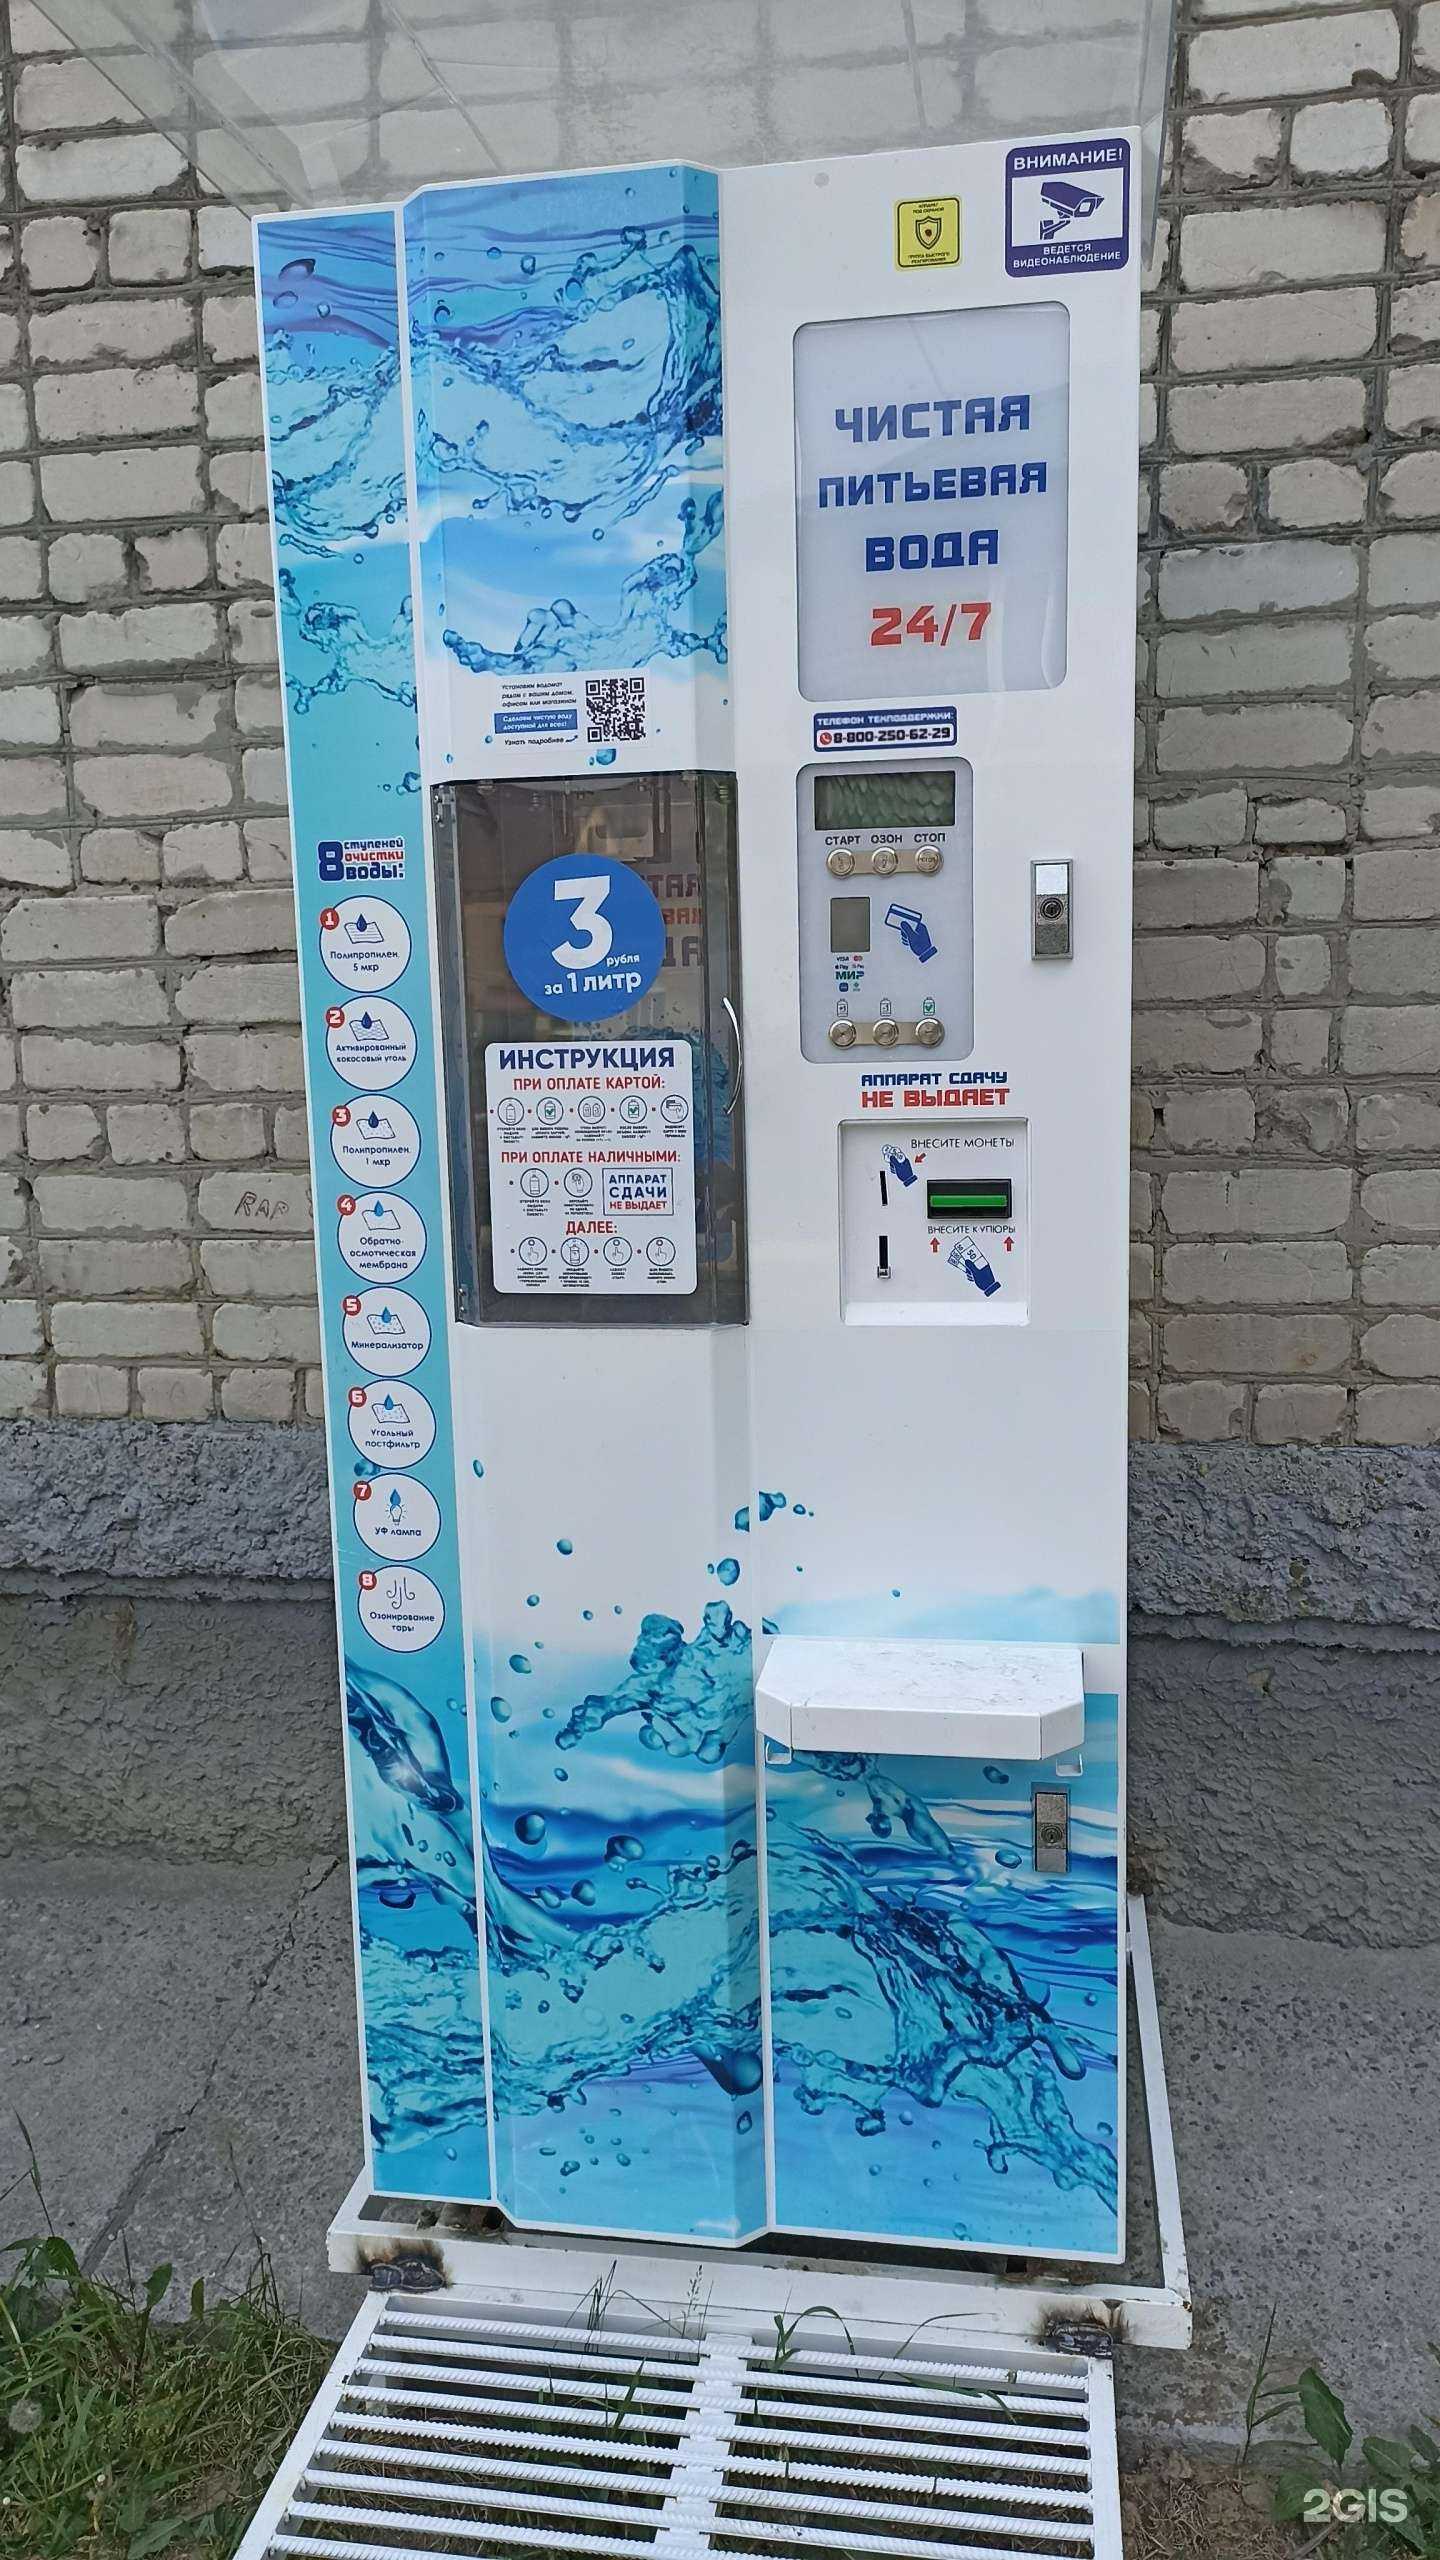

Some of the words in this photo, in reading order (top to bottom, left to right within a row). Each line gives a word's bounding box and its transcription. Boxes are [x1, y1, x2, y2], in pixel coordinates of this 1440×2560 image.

[1014, 148, 1123, 170] ВНИМАНИЕ!
[1043, 243, 1092, 255] ВЕДЕТСЯ
[1013, 252, 1121, 268] ВИДЕОНАБЛЮДЕНИЕ
[835, 394, 1030, 443] ЧИСТАЯ
[818, 461, 1047, 509] ПИТЬЕВАЯ
[865, 529, 999, 573] ВОДА
[870, 602, 992, 646] 24/7
[816, 718, 865, 726] ТЕЛЕФОН
[834, 727, 951, 744] 8-800-250-62-29
[825, 835, 861, 846] СТАРТ
[870, 834, 903, 844] ОЗОН
[914, 832, 946, 843] СТОП
[318, 841, 344, 881] 8
[344, 837, 404, 851] ступеней
[344, 850, 404, 862] очистки
[346, 861, 404, 880] воды:
[326, 912, 334, 926] 1
[551, 875, 613, 970] 3
[606, 954, 640, 967] рубля
[353, 963, 358, 972] 5
[360, 964, 379, 972] мкр
[835, 971, 865, 980] МИР
[544, 984, 563, 995] за
[567, 973, 578, 992] 1
[583, 971, 642, 993] литр
[329, 1010, 341, 1024] 2
[336, 1043, 406, 1052] Активированный
[336, 1055, 382, 1063] кокосовый
[384, 1055, 406, 1063] уголь
[499, 1047, 675, 1071] ИНСТРУКЦИЯ
[513, 1078, 542, 1090] ПРИ
[547, 1077, 601, 1090] ОПЛАТЕ
[605, 1074, 666, 1089] КАРТОЙ:
[861, 1073, 942, 1087] АППАРАТ
[949, 1071, 1008, 1085] СДАЧУ
[861, 1090, 894, 1108] НЕ
[903, 1088, 1010, 1107] ВЫДАЕТ
[336, 1109, 347, 1122] 3
[911, 1138, 960, 1149] ВНЕСИТЕ
[964, 1137, 1015, 1149] МОНЕТЫ
[372, 1158, 391, 1167] мкр
[501, 1151, 528, 1164] ПРИ
[532, 1151, 583, 1163] ОПЛАТЕ
[588, 1150, 681, 1163] НАЛИЧНЫМИ:
[609, 1174, 667, 1184] АППАРАТ
[609, 1186, 667, 1200] СДАЧИ
[234, 1191, 289, 1221] RAP
[341, 1199, 352, 1212] 4
[609, 1201, 623, 1210] НЕ
[625, 1201, 668, 1210] ВЫДАЕТ
[565, 1220, 618, 1236] ДАЛЕЕ:
[927, 1225, 970, 1235] ВНЕСИТЕ
[972, 1225, 1016, 1234] КУПЮРЫ
[967, 1249, 977, 1260] 50
[359, 1261, 408, 1269] мембрана
[346, 1299, 357, 1311] 5
[351, 1341, 424, 1351] Минерализатор
[352, 1391, 363, 1403] 6
[371, 1428, 414, 1438] Угольный
[365, 1440, 421, 1450] постфильтр
[357, 1484, 368, 1497] 7
[374, 1527, 389, 1536] УФ
[390, 1528, 422, 1537] лампа
[362, 1575, 374, 1587] 8
[369, 1612, 435, 1622] Озонирование
